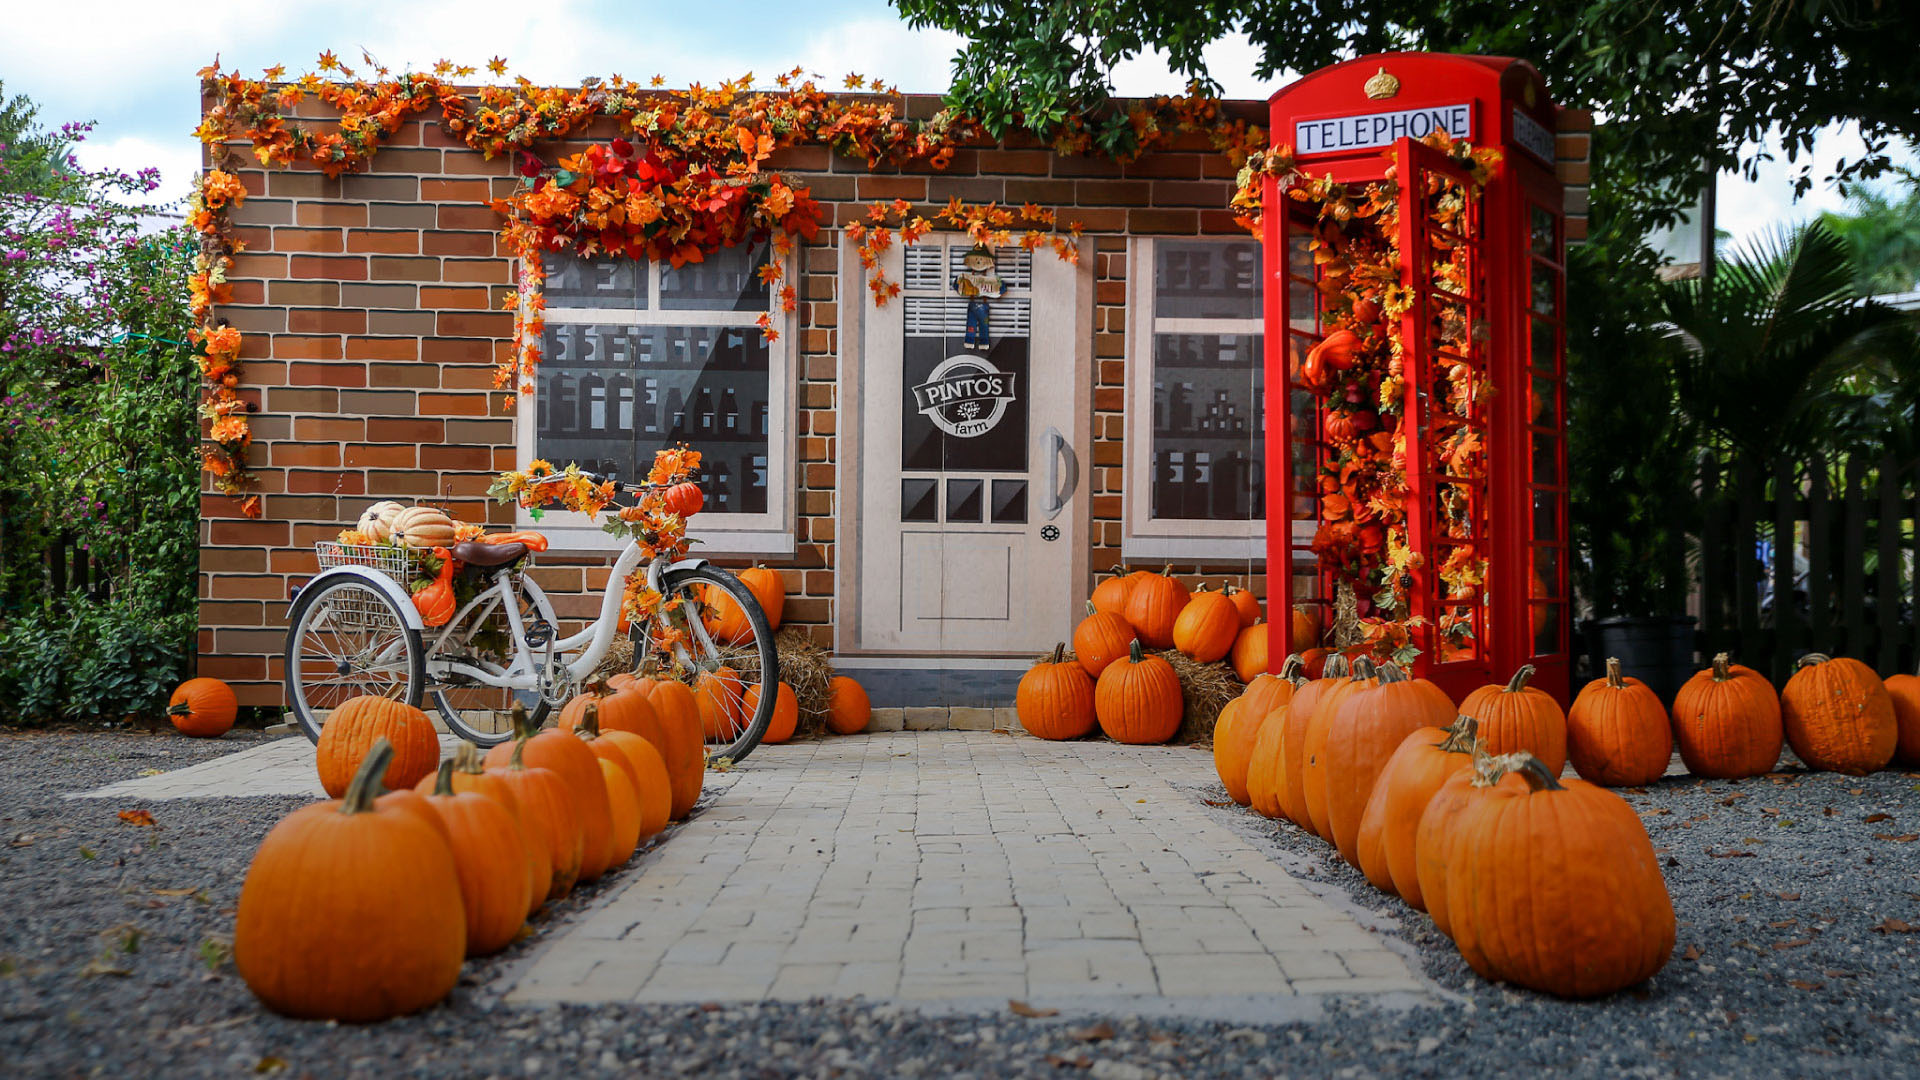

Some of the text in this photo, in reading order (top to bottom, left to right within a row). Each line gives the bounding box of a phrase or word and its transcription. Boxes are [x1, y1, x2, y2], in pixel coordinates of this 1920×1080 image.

[1298, 107, 1467, 150] TELEPHONE
[925, 375, 1003, 405] PINTO'S
[954, 422, 988, 435] farm
